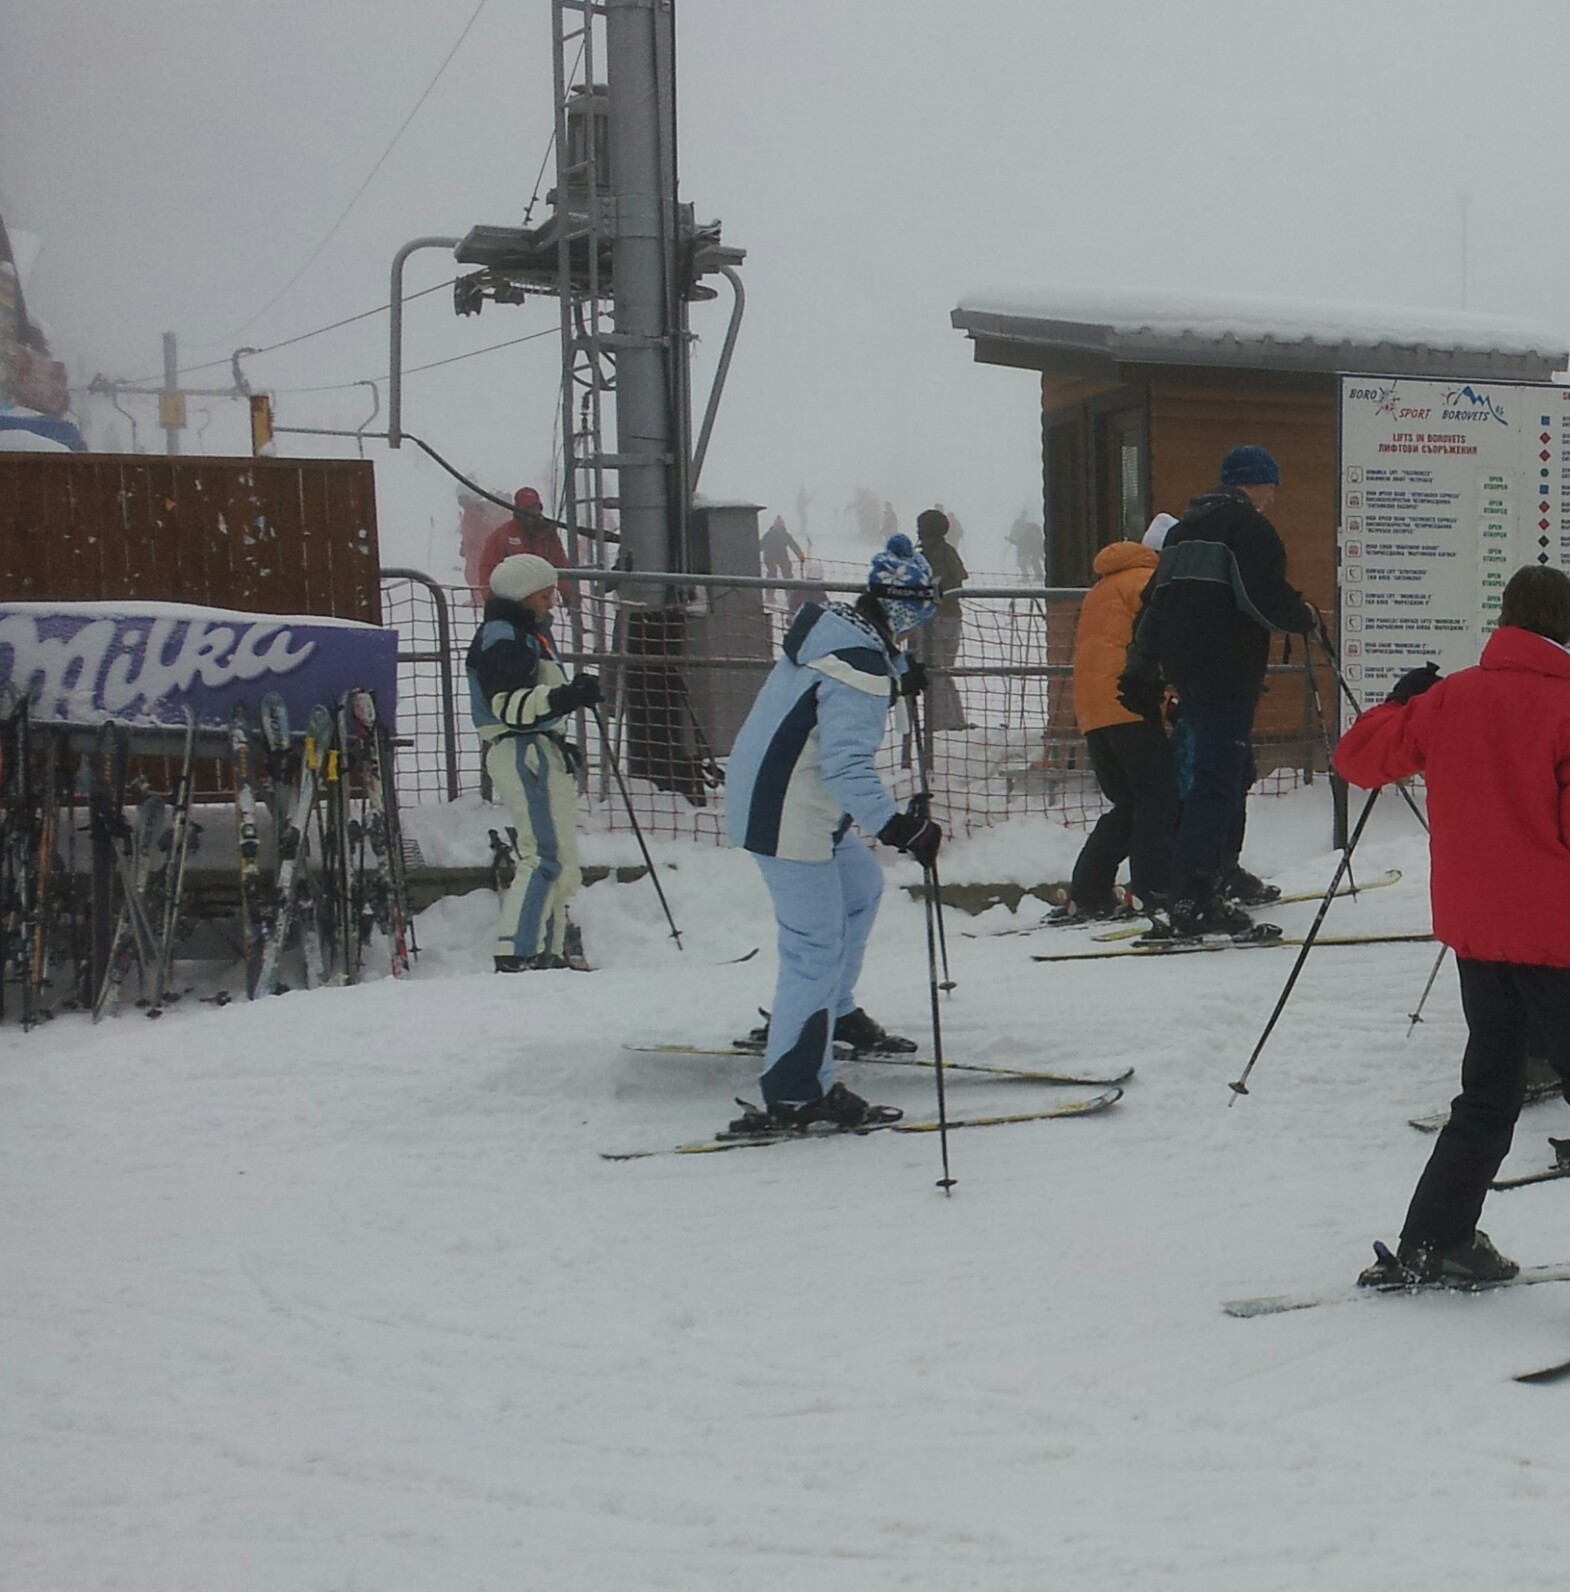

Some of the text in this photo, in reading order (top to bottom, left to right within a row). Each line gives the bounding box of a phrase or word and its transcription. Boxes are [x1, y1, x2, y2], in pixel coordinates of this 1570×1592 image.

[1348, 388, 1377, 400] BORO
[1398, 408, 1432, 420] SPORT
[1441, 409, 1491, 422] BOROVETS
[1392, 432, 1467, 444] LIFTS IN BOROVETS
[1378, 443, 1478, 455] ЛИФТОВИ СЪОРЪЖЕНИЯ
[0, 616, 316, 712] Milka
